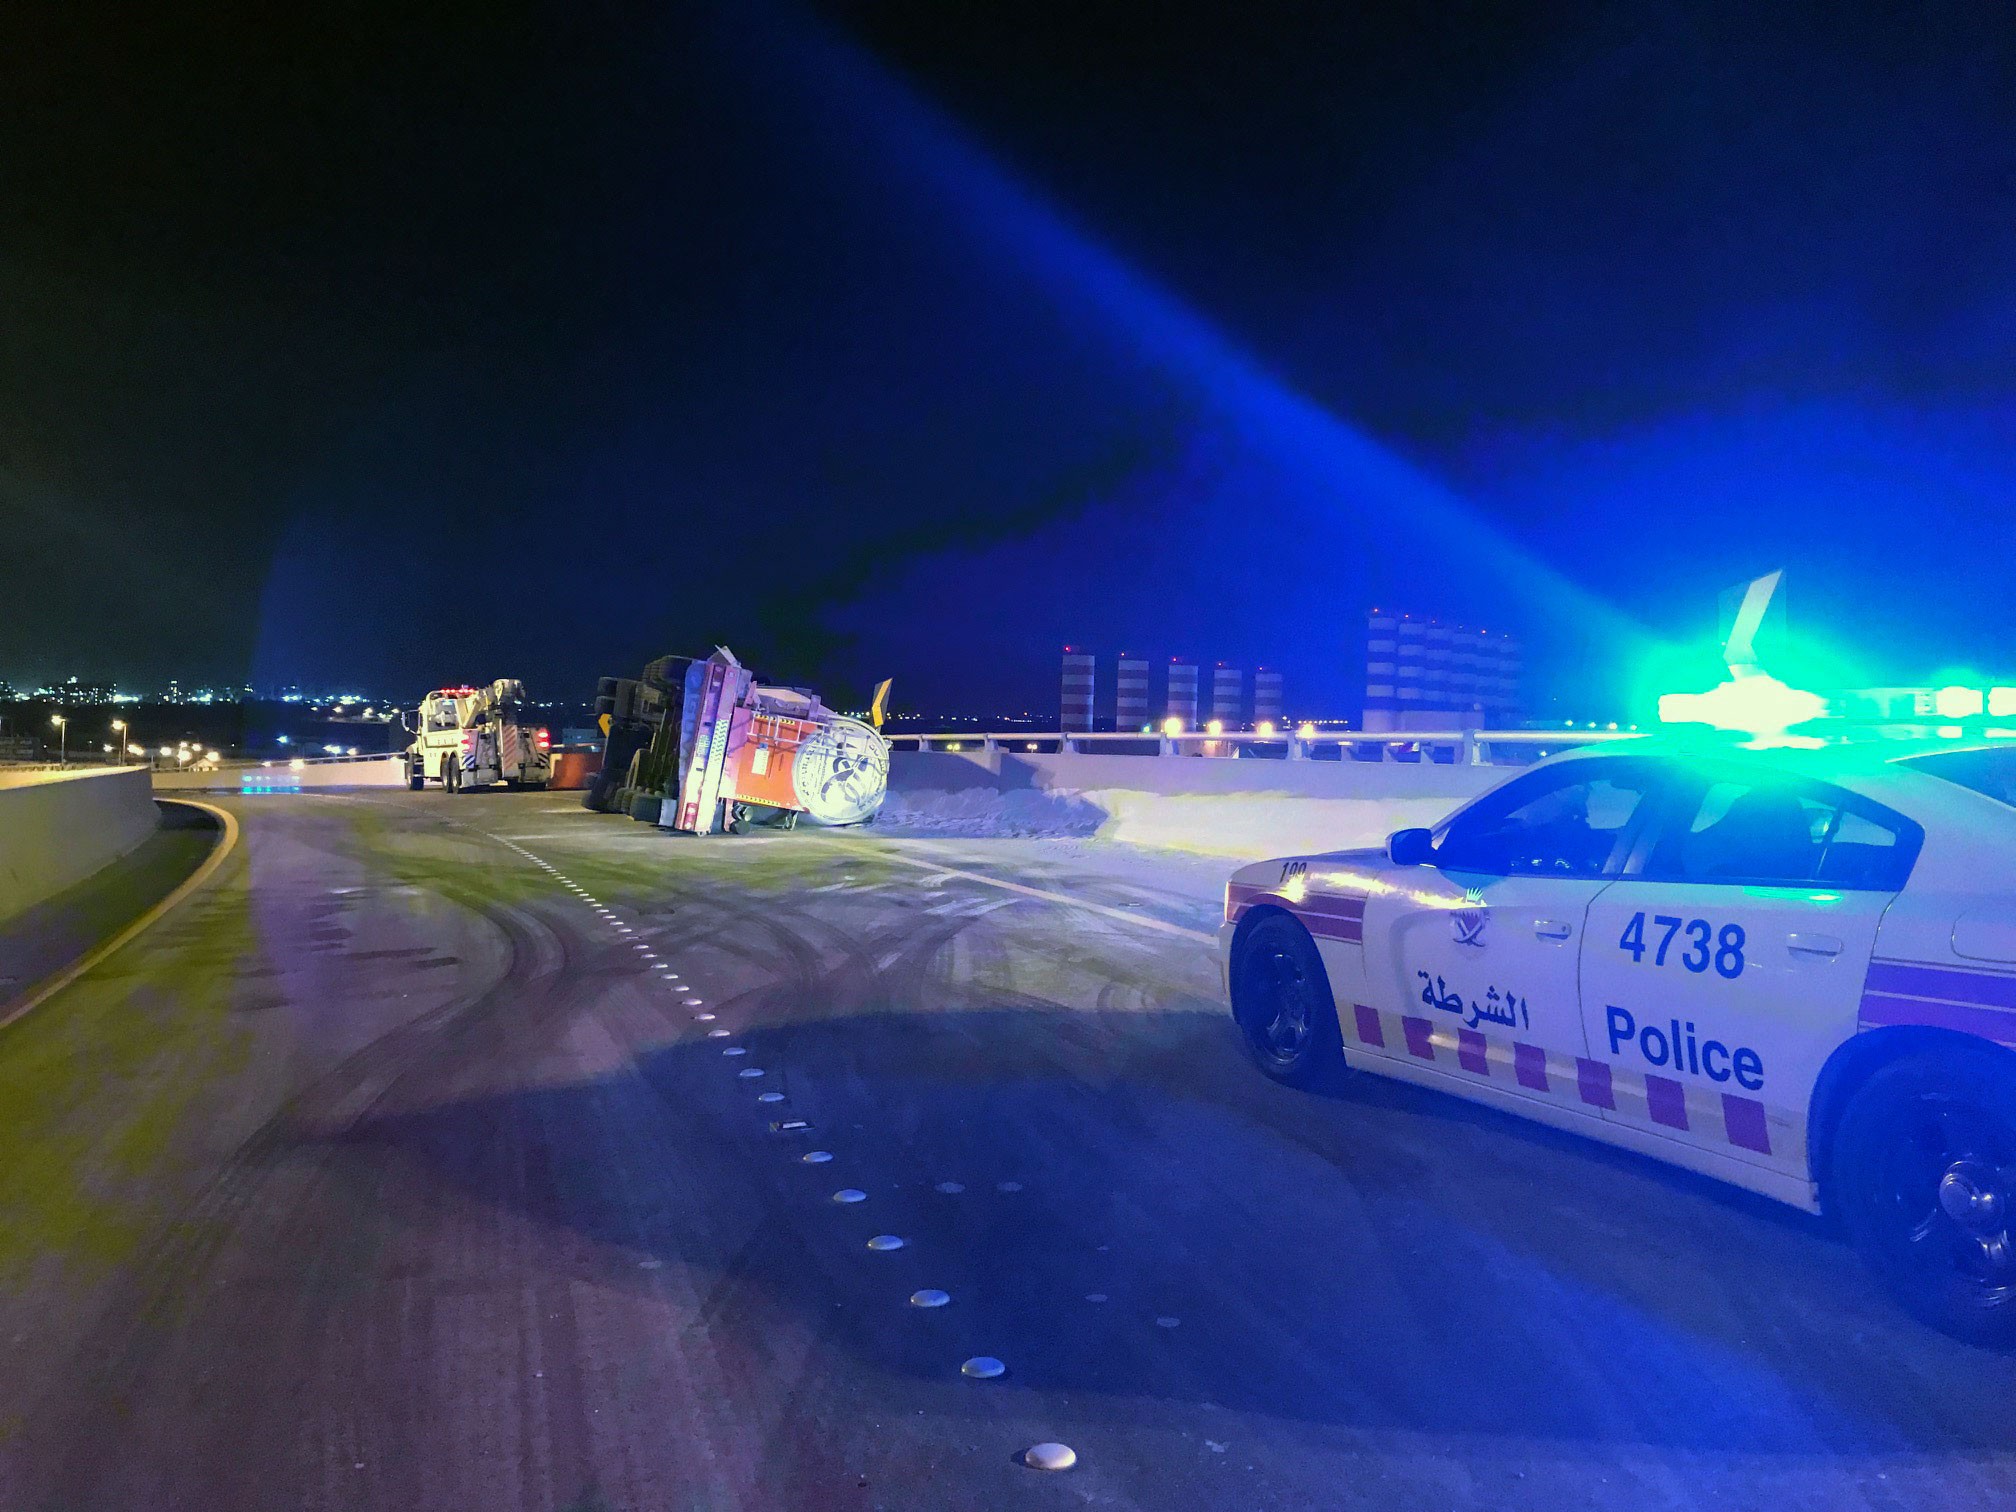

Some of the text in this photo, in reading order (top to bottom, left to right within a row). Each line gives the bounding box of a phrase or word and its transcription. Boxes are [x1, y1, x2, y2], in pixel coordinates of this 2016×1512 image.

[1620, 912, 1746, 979] 4738
[1418, 970, 1529, 1030] الشرطة
[1606, 1005, 1764, 1091] Police
